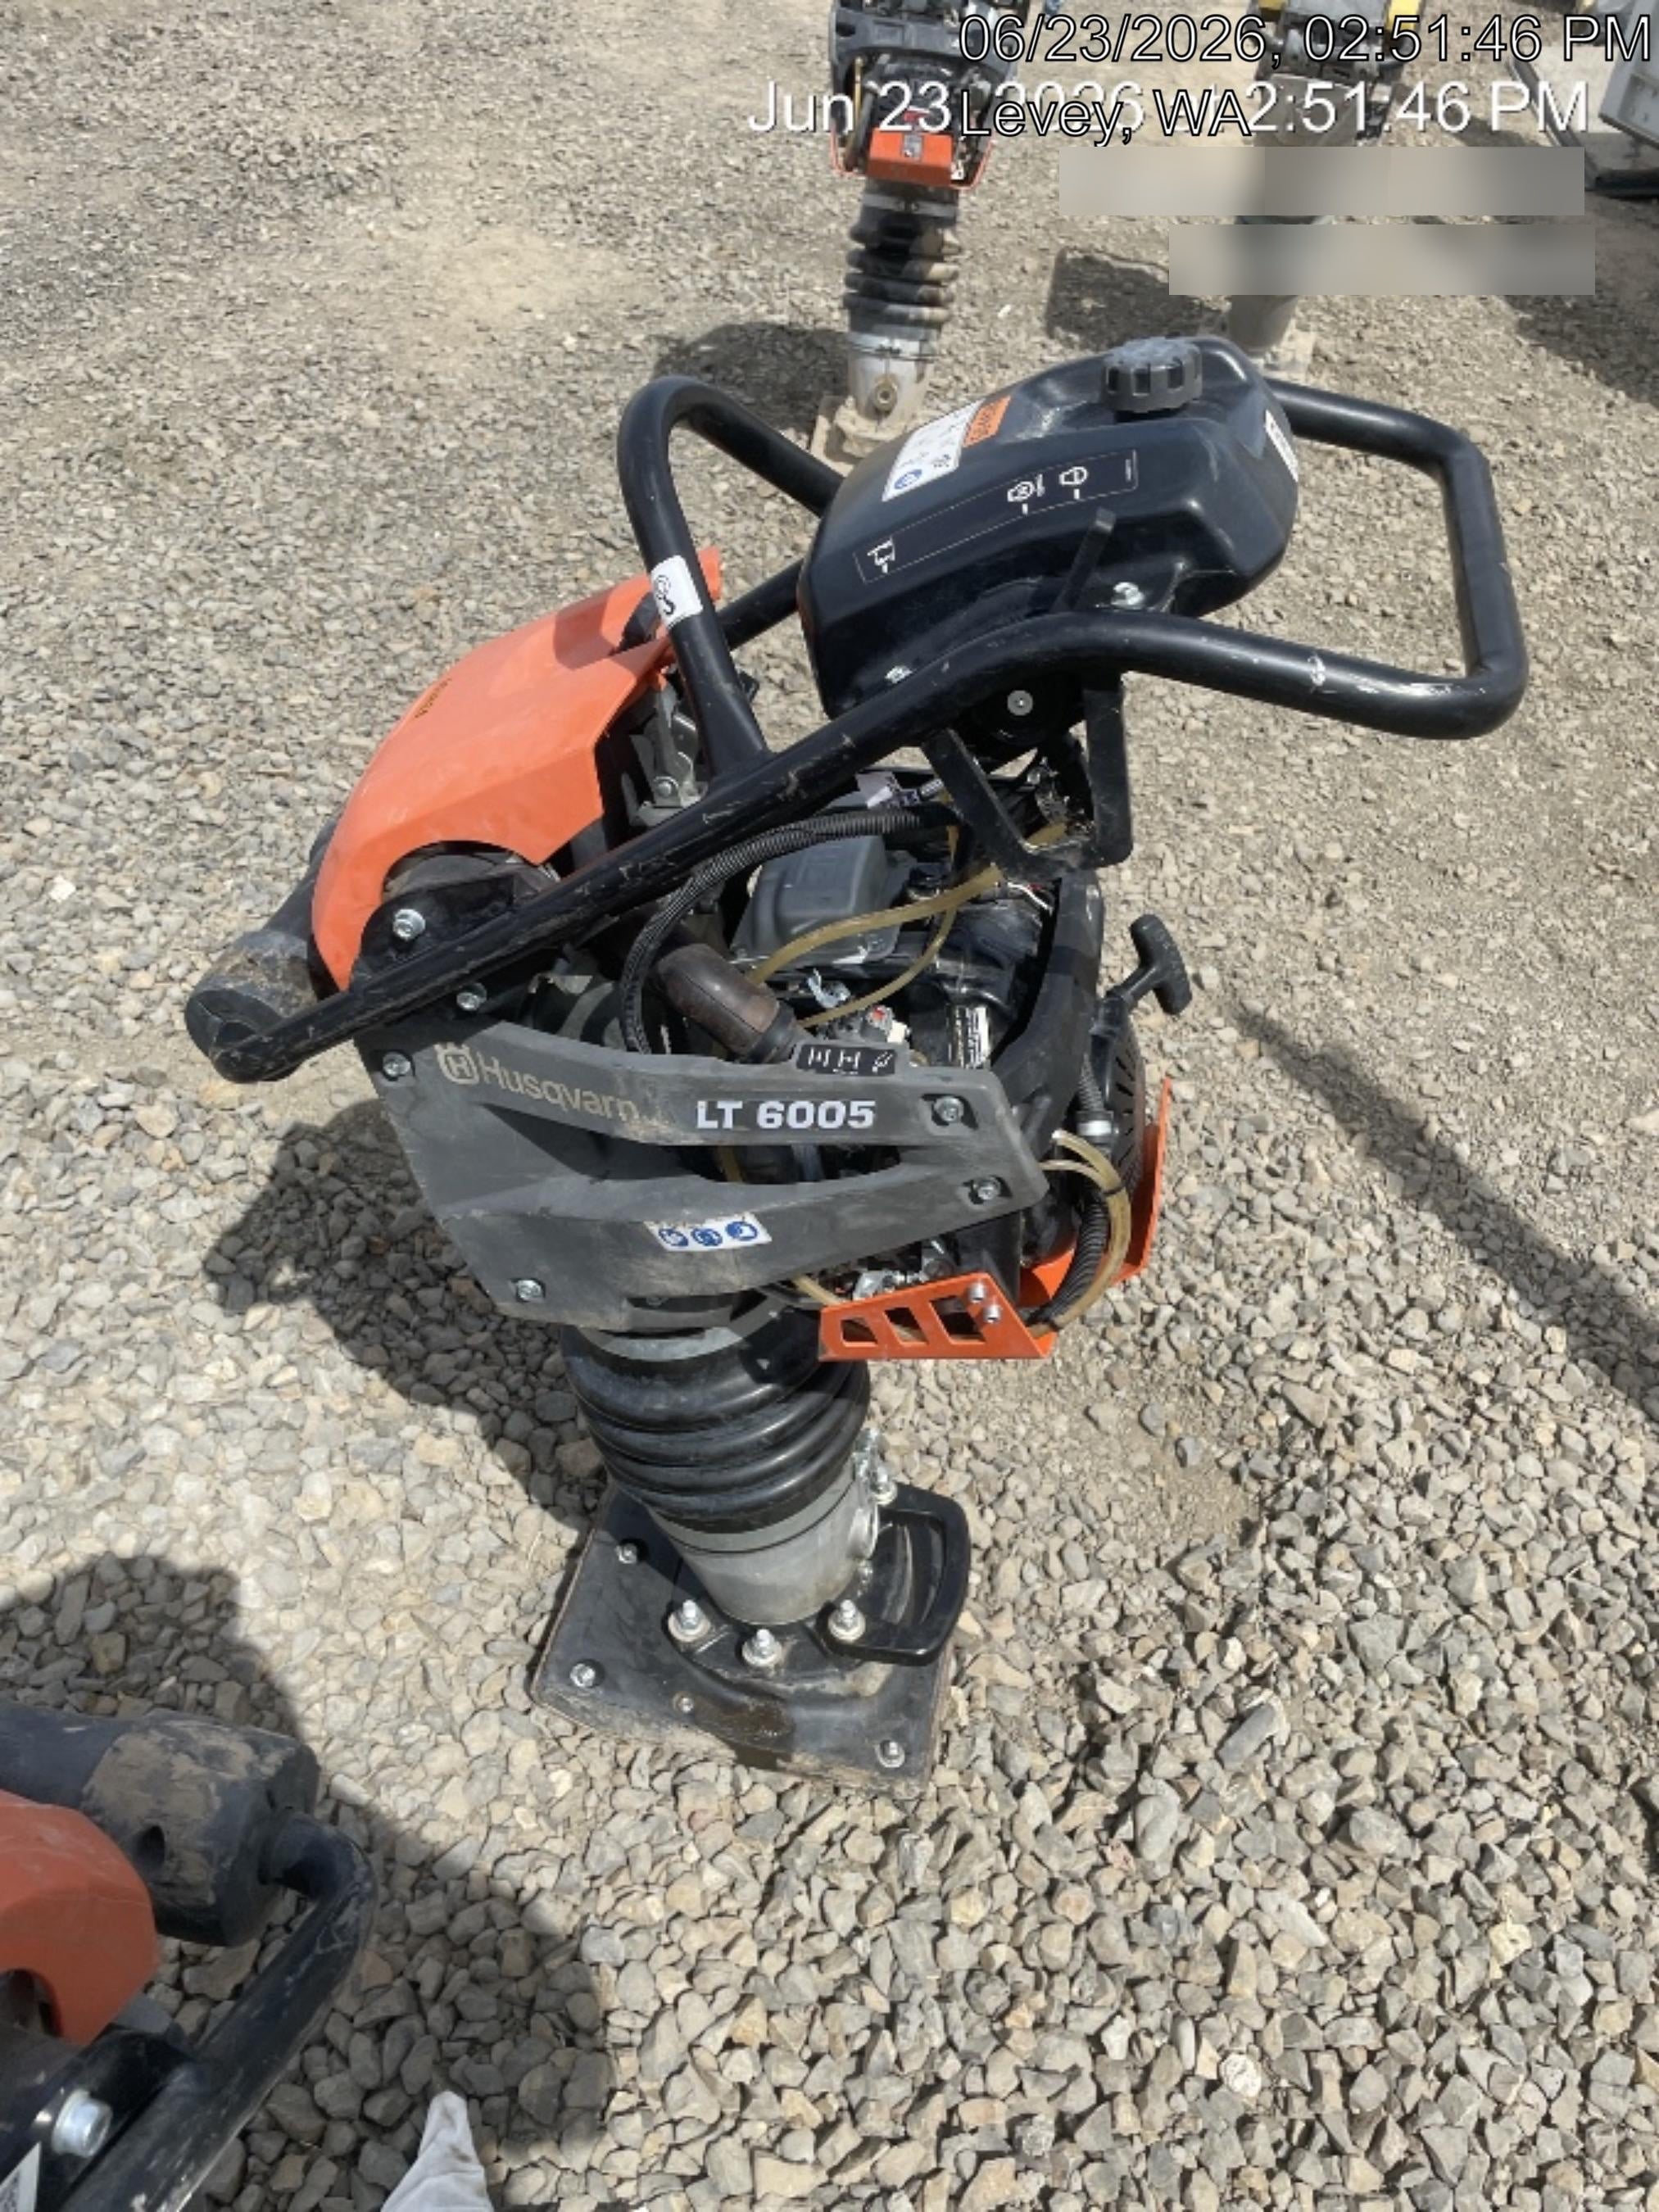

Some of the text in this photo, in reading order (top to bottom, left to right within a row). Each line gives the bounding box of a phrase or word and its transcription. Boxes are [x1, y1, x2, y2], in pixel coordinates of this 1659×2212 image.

[476, 1051, 654, 1124] Husqvarn
[696, 1099, 877, 1130] LT 6005
